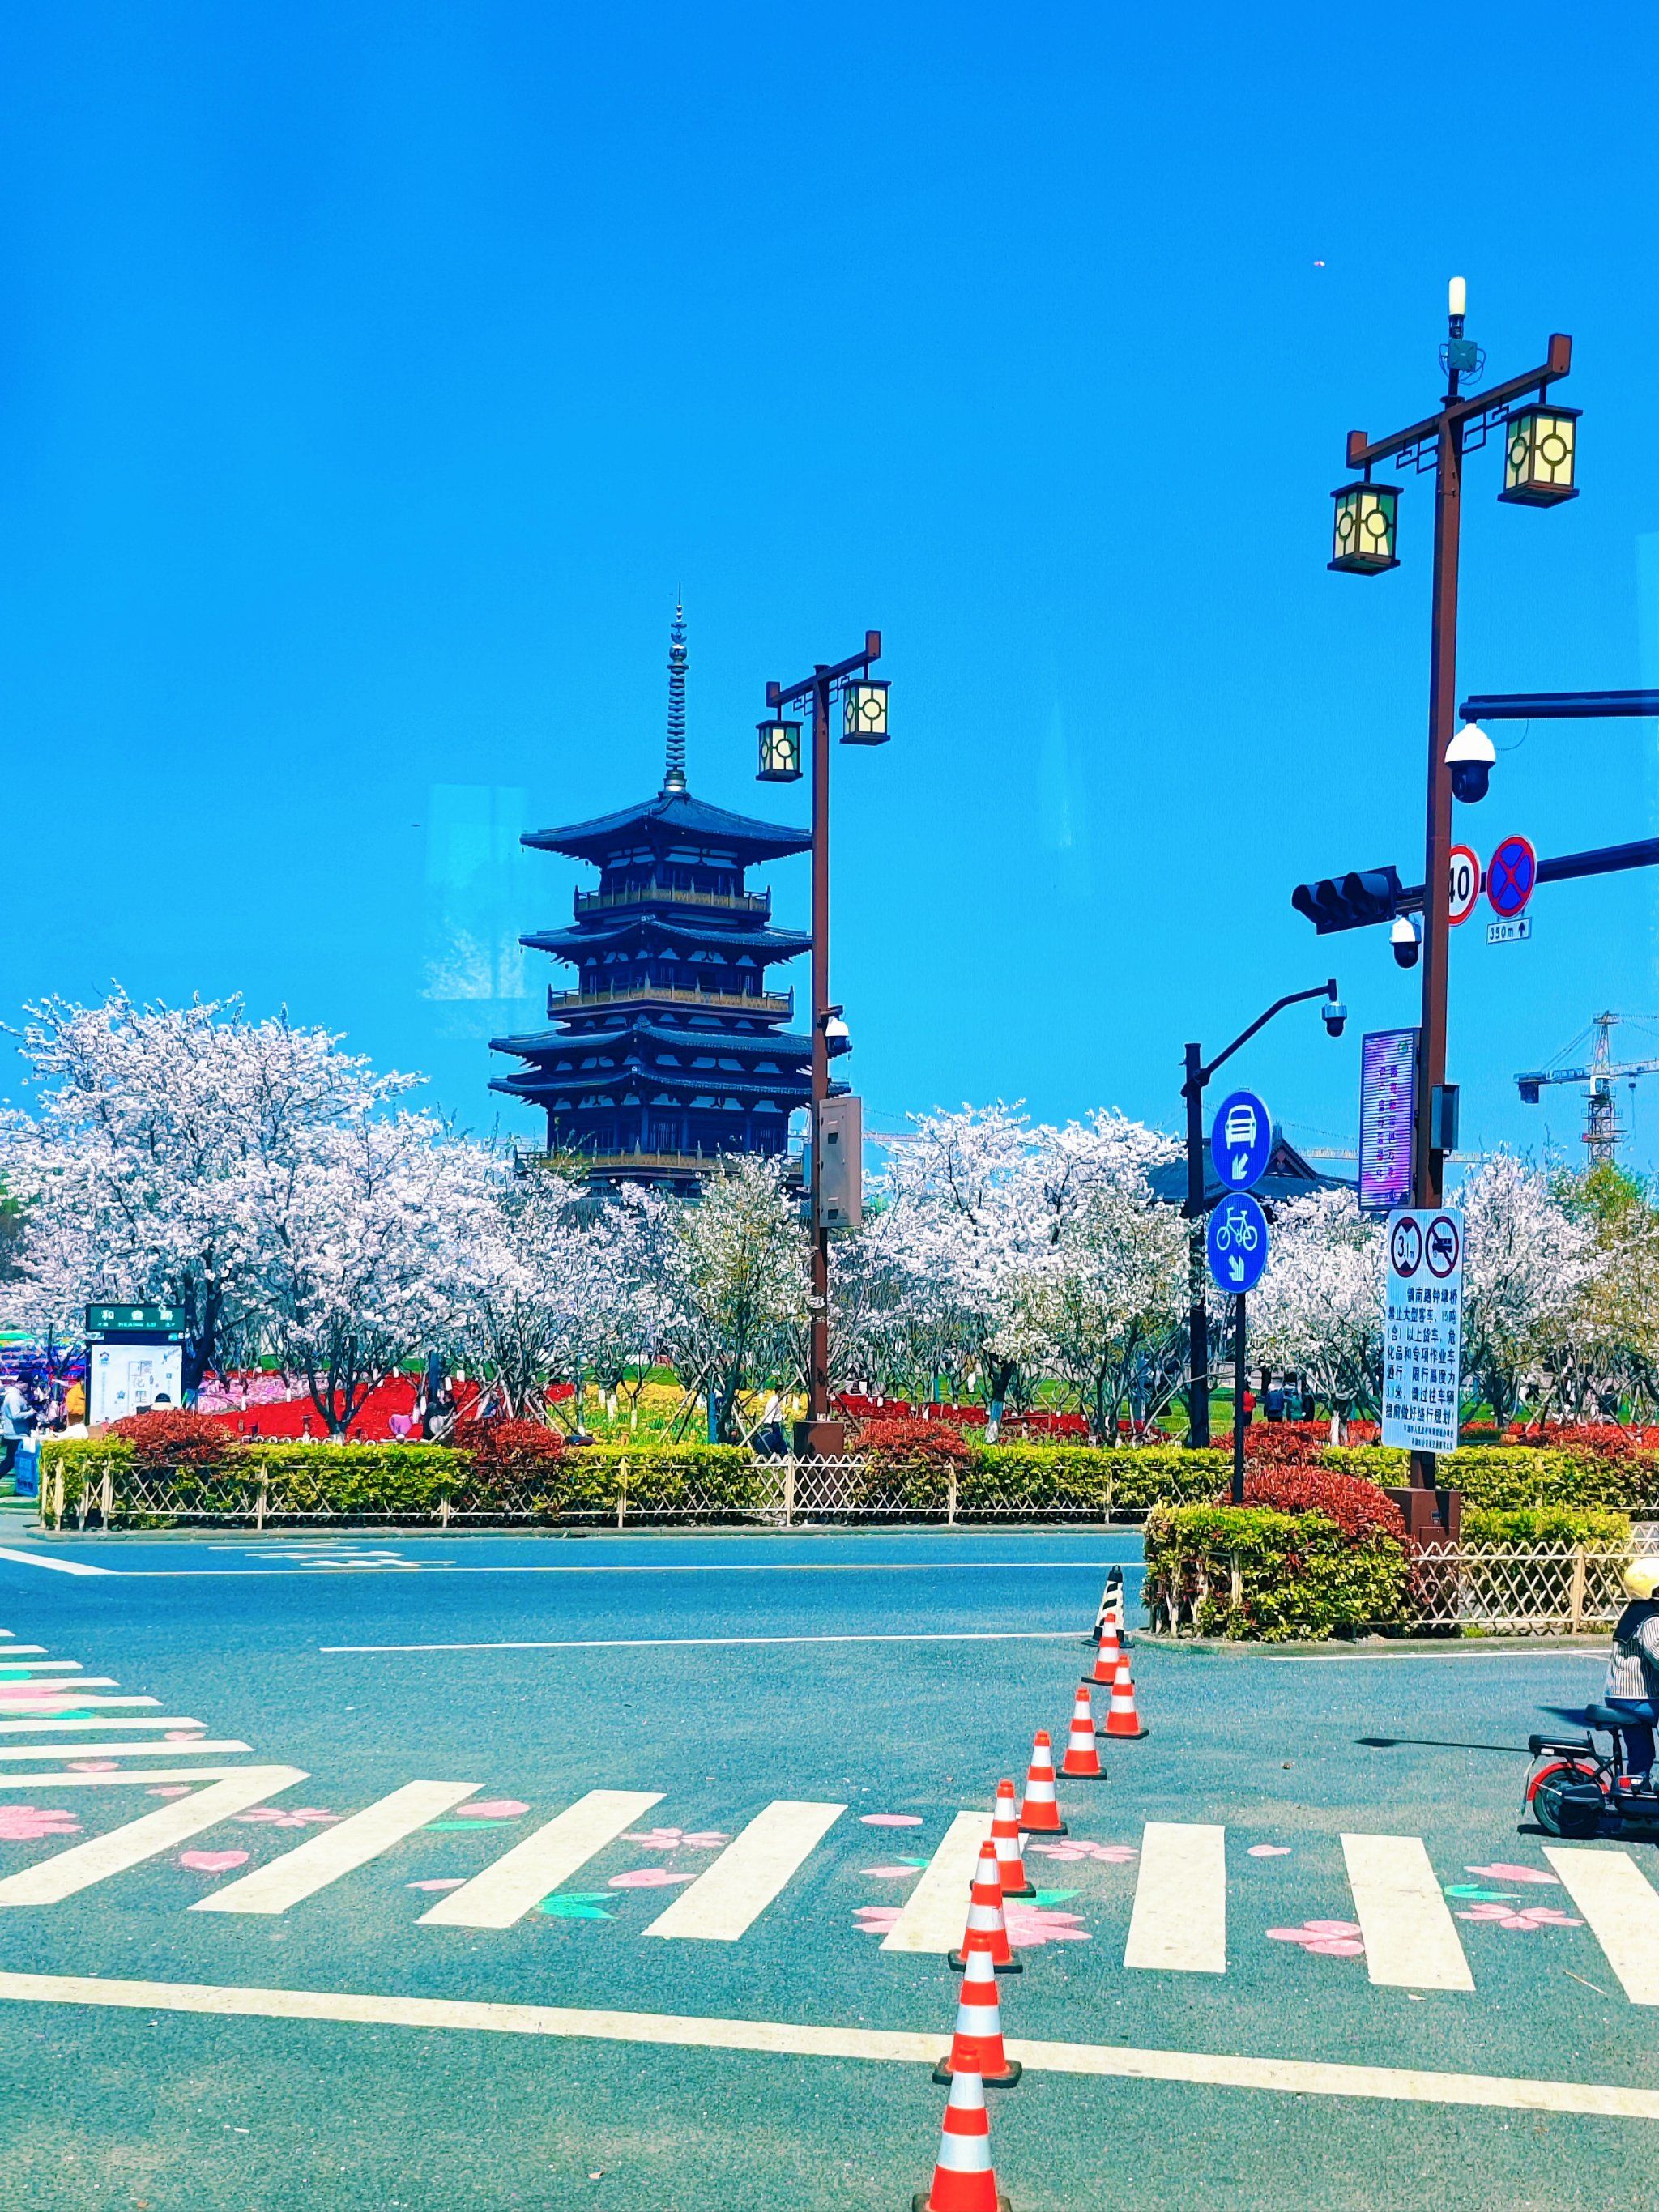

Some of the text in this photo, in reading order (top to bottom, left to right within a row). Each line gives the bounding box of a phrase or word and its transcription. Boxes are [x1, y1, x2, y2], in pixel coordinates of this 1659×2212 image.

[1489, 926, 1514, 940] 350m
[1398, 1235, 1415, 1258] 3.1m
[1387, 1345, 1456, 1366] 化品和专项作业车
